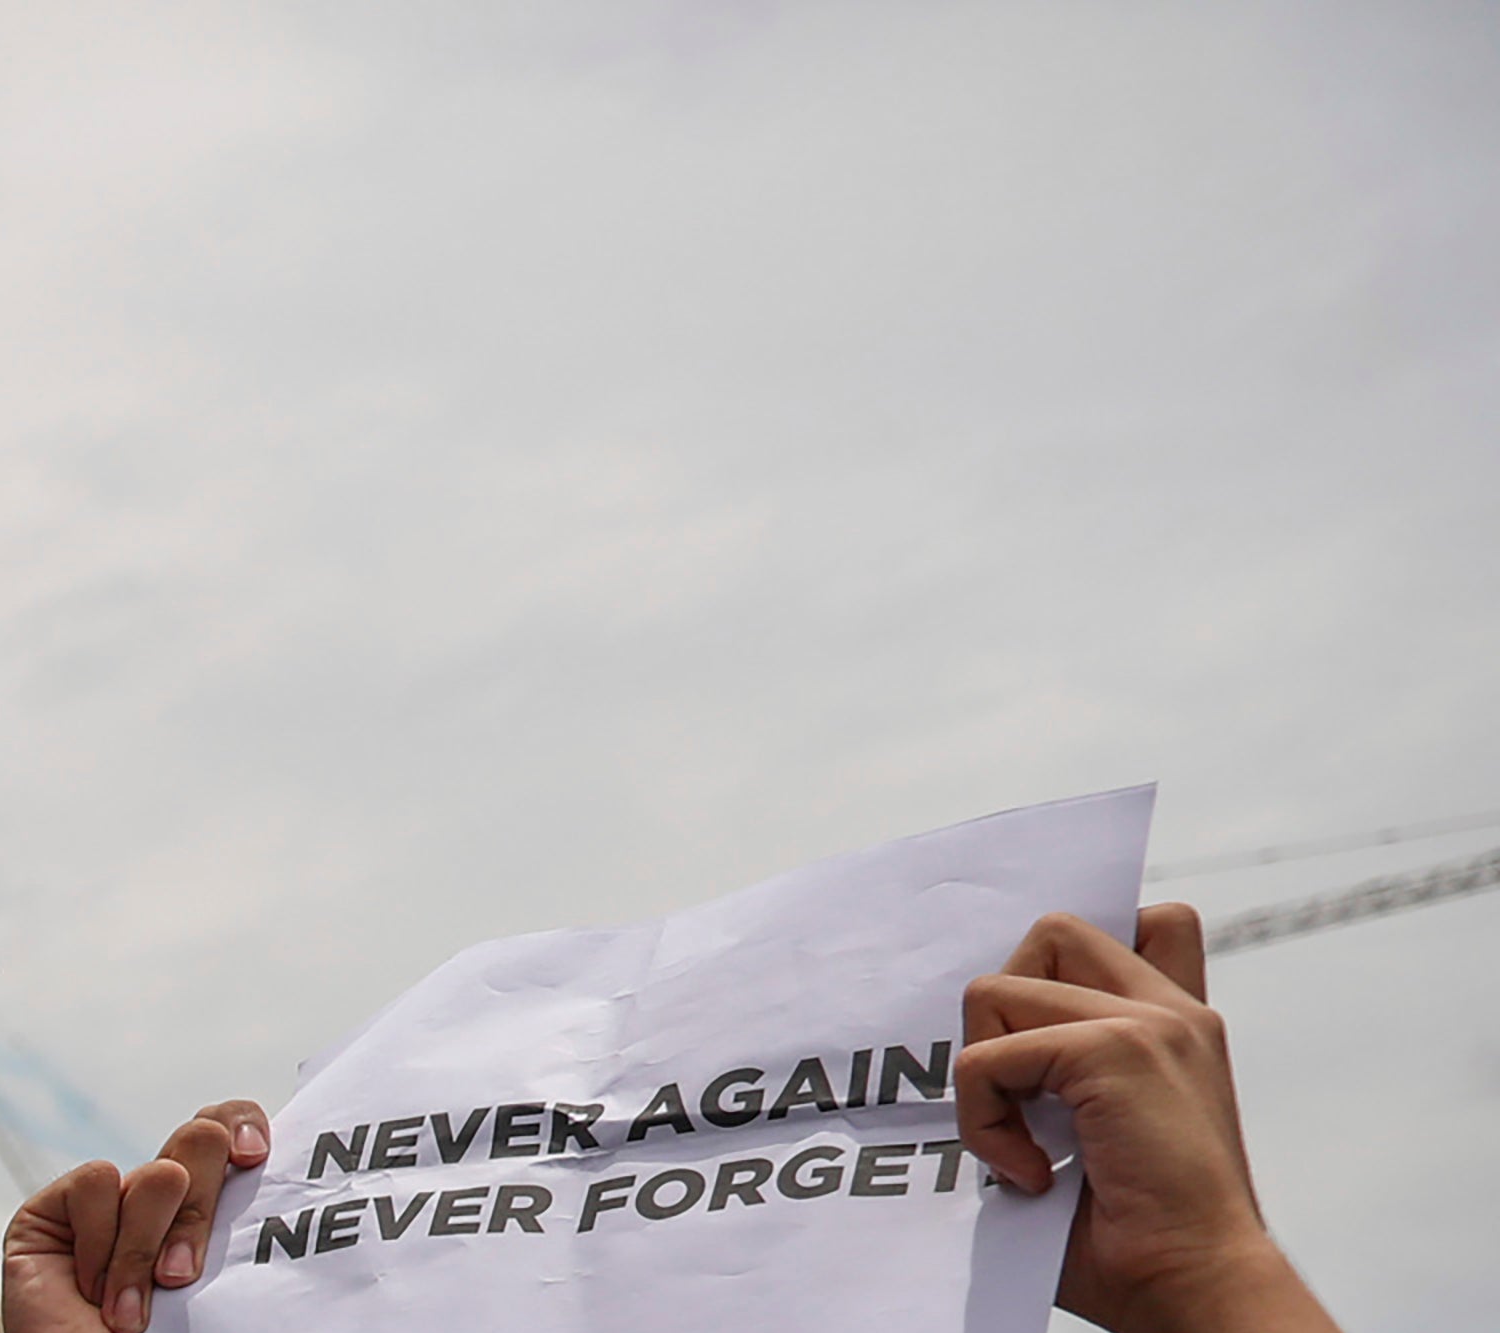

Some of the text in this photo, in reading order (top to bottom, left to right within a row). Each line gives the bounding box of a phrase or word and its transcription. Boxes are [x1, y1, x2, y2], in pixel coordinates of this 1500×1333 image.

[306, 1038, 950, 1180] NEVER AGAIN
[253, 1138, 1000, 1265] NEVER FORGET
